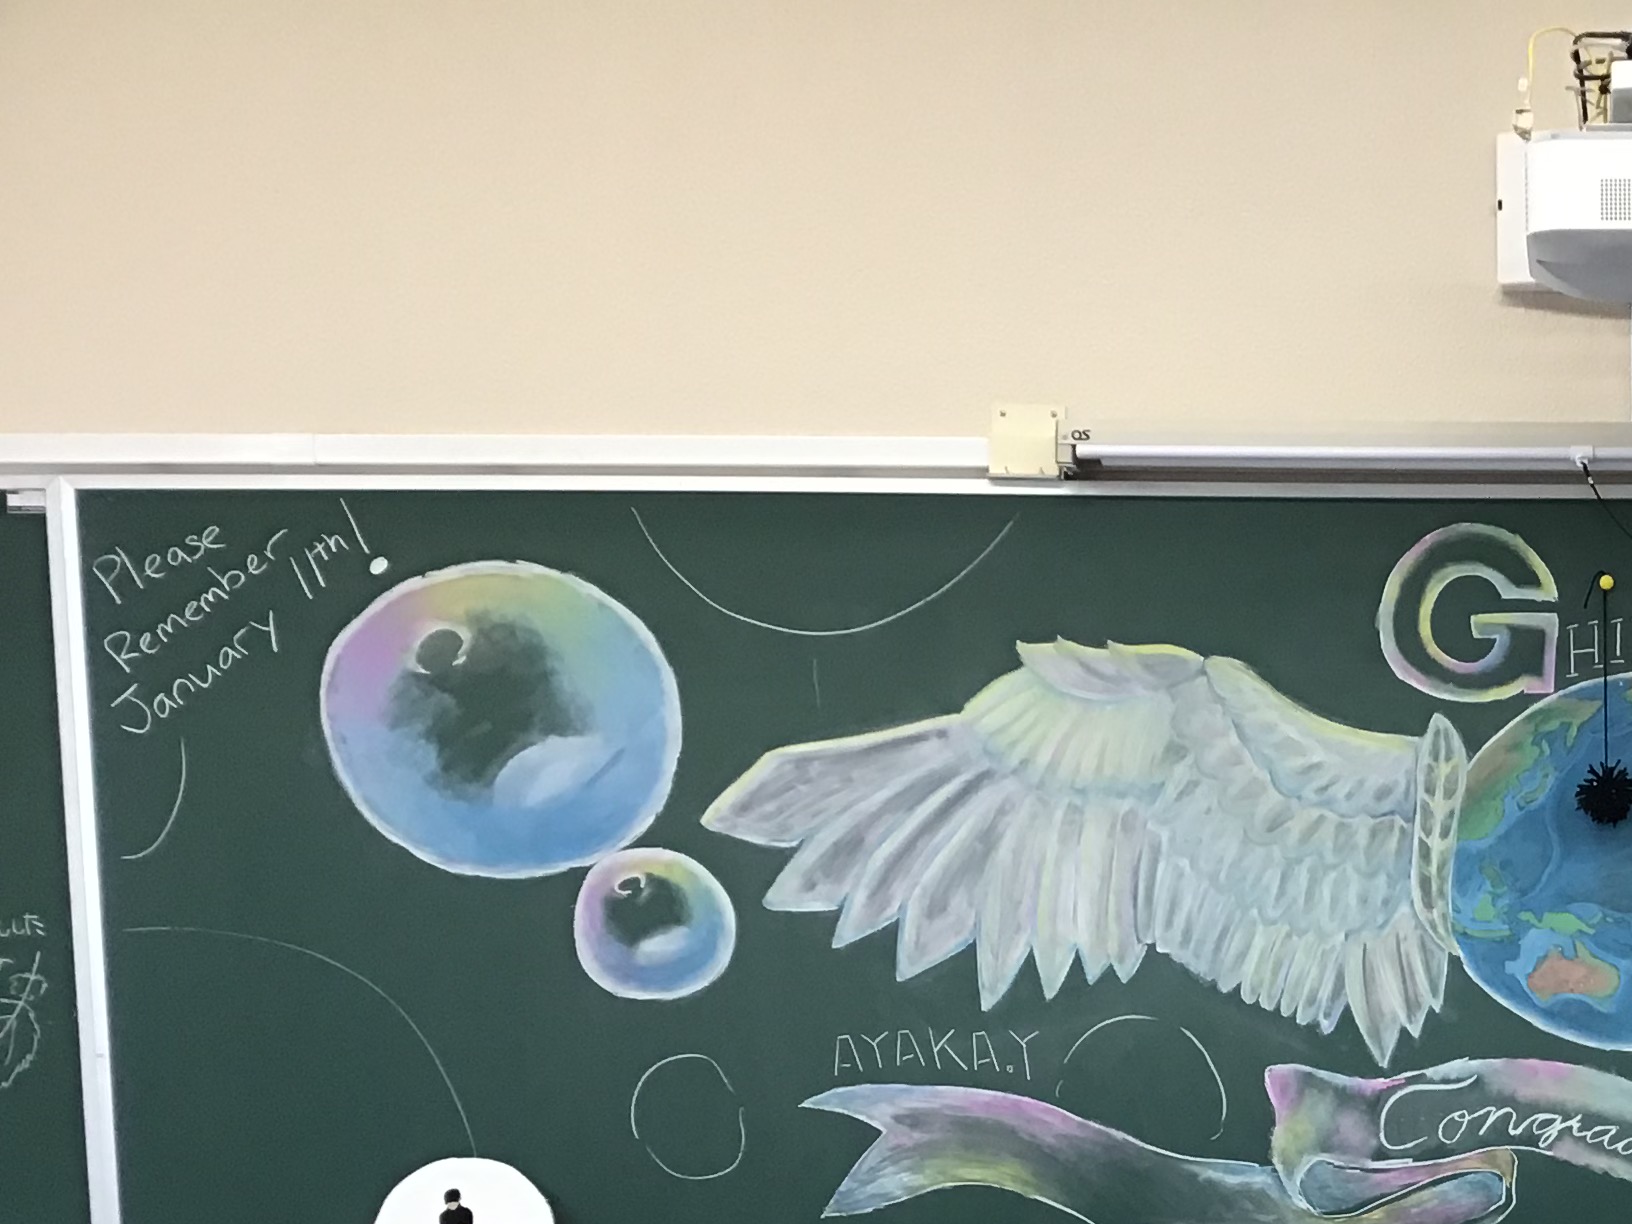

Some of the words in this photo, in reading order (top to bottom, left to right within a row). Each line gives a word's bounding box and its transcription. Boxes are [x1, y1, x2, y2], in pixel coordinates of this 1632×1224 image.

[92, 525, 226, 605] Please
[103, 528, 289, 673] Remember
[1378, 521, 1558, 703] G
[110, 609, 278, 734] January
